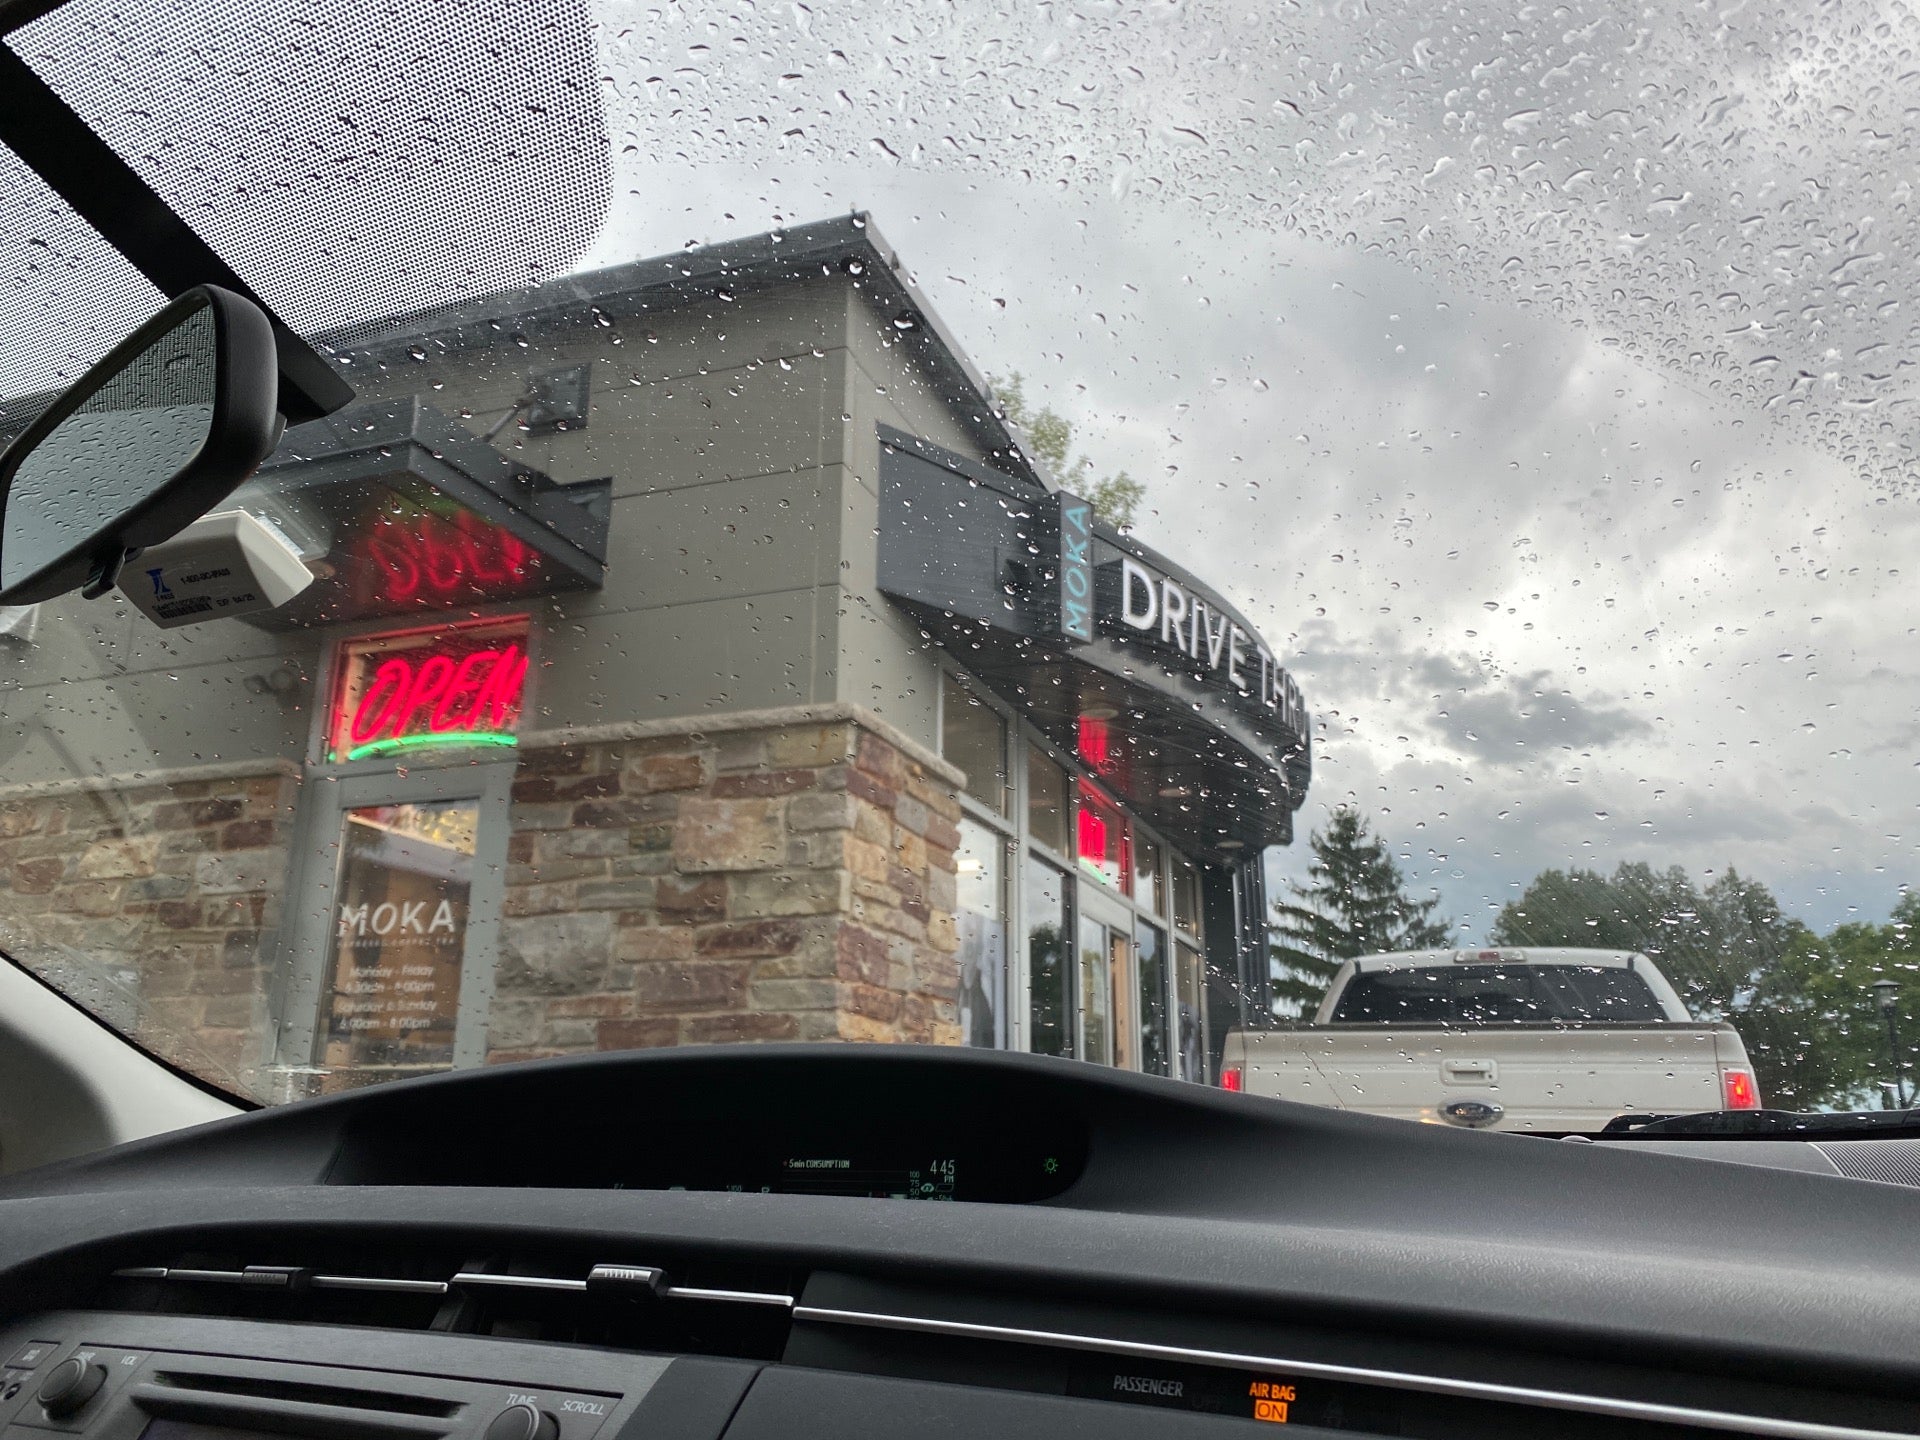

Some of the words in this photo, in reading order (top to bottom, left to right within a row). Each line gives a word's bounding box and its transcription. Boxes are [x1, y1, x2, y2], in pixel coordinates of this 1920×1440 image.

[1065, 504, 1090, 637] MOKA
[1122, 558, 1250, 691] DRIVE
[351, 645, 529, 744] OPEN
[338, 899, 455, 938] MOKA
[349, 967, 393, 979] Monday
[806, 1160, 851, 1169] CONSUMPTION
[909, 1179, 921, 1188] 75
[944, 1175, 955, 1184] PM
[909, 1188, 921, 1197] 50
[1113, 1375, 1183, 1397] PASSENGER
[1249, 1382, 1269, 1398] AIR
[1271, 1384, 1296, 1401] BAG
[560, 1399, 605, 1416] SCROLL
[1256, 1402, 1286, 1421] ON
